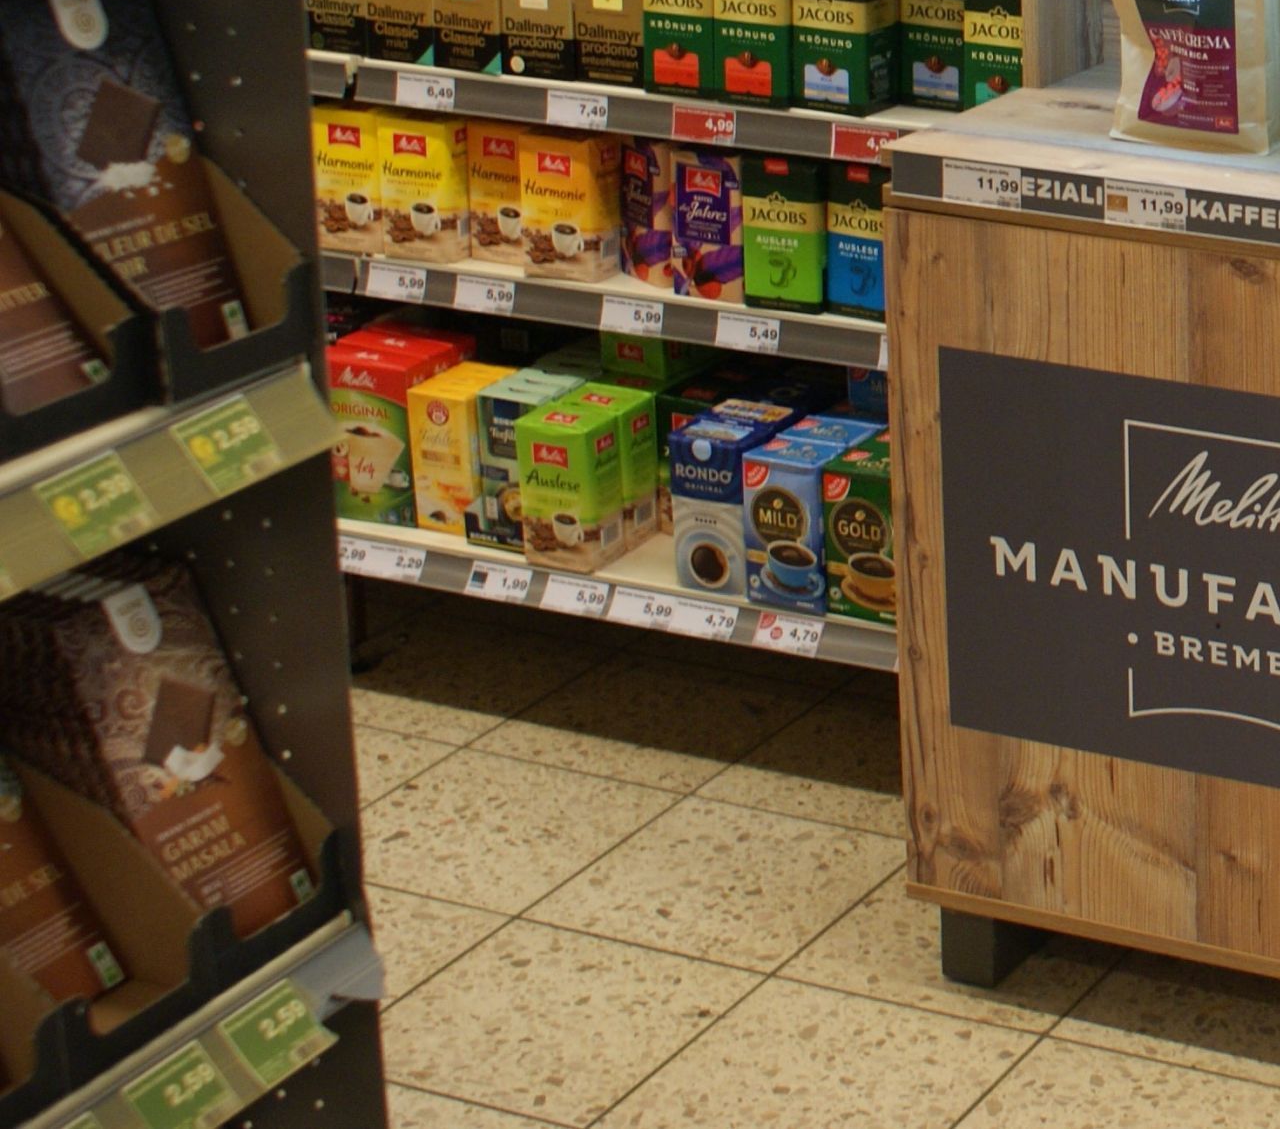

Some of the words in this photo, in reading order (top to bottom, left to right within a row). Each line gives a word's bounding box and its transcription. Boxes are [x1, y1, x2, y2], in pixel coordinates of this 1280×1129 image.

[367, 3, 425, 22] Dallmayr
[720, 0, 776, 19] JACOBS
[799, 6, 854, 26] JACOBS
[907, 4, 964, 22] JACOBS
[434, 11, 491, 31] Dallmayr
[506, 18, 564, 37] Dallmayr
[650, 20, 702, 33] KRÖNUNG
[374, 22, 419, 39] Classic
[441, 30, 485, 47] Classic
[577, 23, 640, 42] Dallmayr
[721, 28, 775, 42] KRÖNUNG
[508, 36, 564, 52] prodomo
[799, 35, 852, 49] KRÖNUNG
[909, 32, 963, 47] KRÖNUNG
[581, 42, 637, 59] prodomo
[427, 87, 453, 99] 6,49
[579, 105, 606, 118] 7,49
[317, 151, 373, 171] Harmonie
[383, 161, 441, 181] Harmonie
[525, 179, 586, 201] Harmonie
[976, 177, 1018, 193] 11,99
[1140, 199, 1184, 215] 11,99
[751, 208, 807, 225] JACOBS
[757, 234, 798, 248] AUSLESE
[839, 241, 878, 255] AUSLESE
[398, 277, 424, 289] 5,99
[486, 289, 513, 302] 5,99
[634, 310, 661, 323] 5,99
[749, 327, 778, 341] 5,49
[526, 471, 581, 493] Auslese
[675, 463, 732, 484] RONDO
[759, 510, 797, 529] MILD
[838, 519, 881, 540] GOLD
